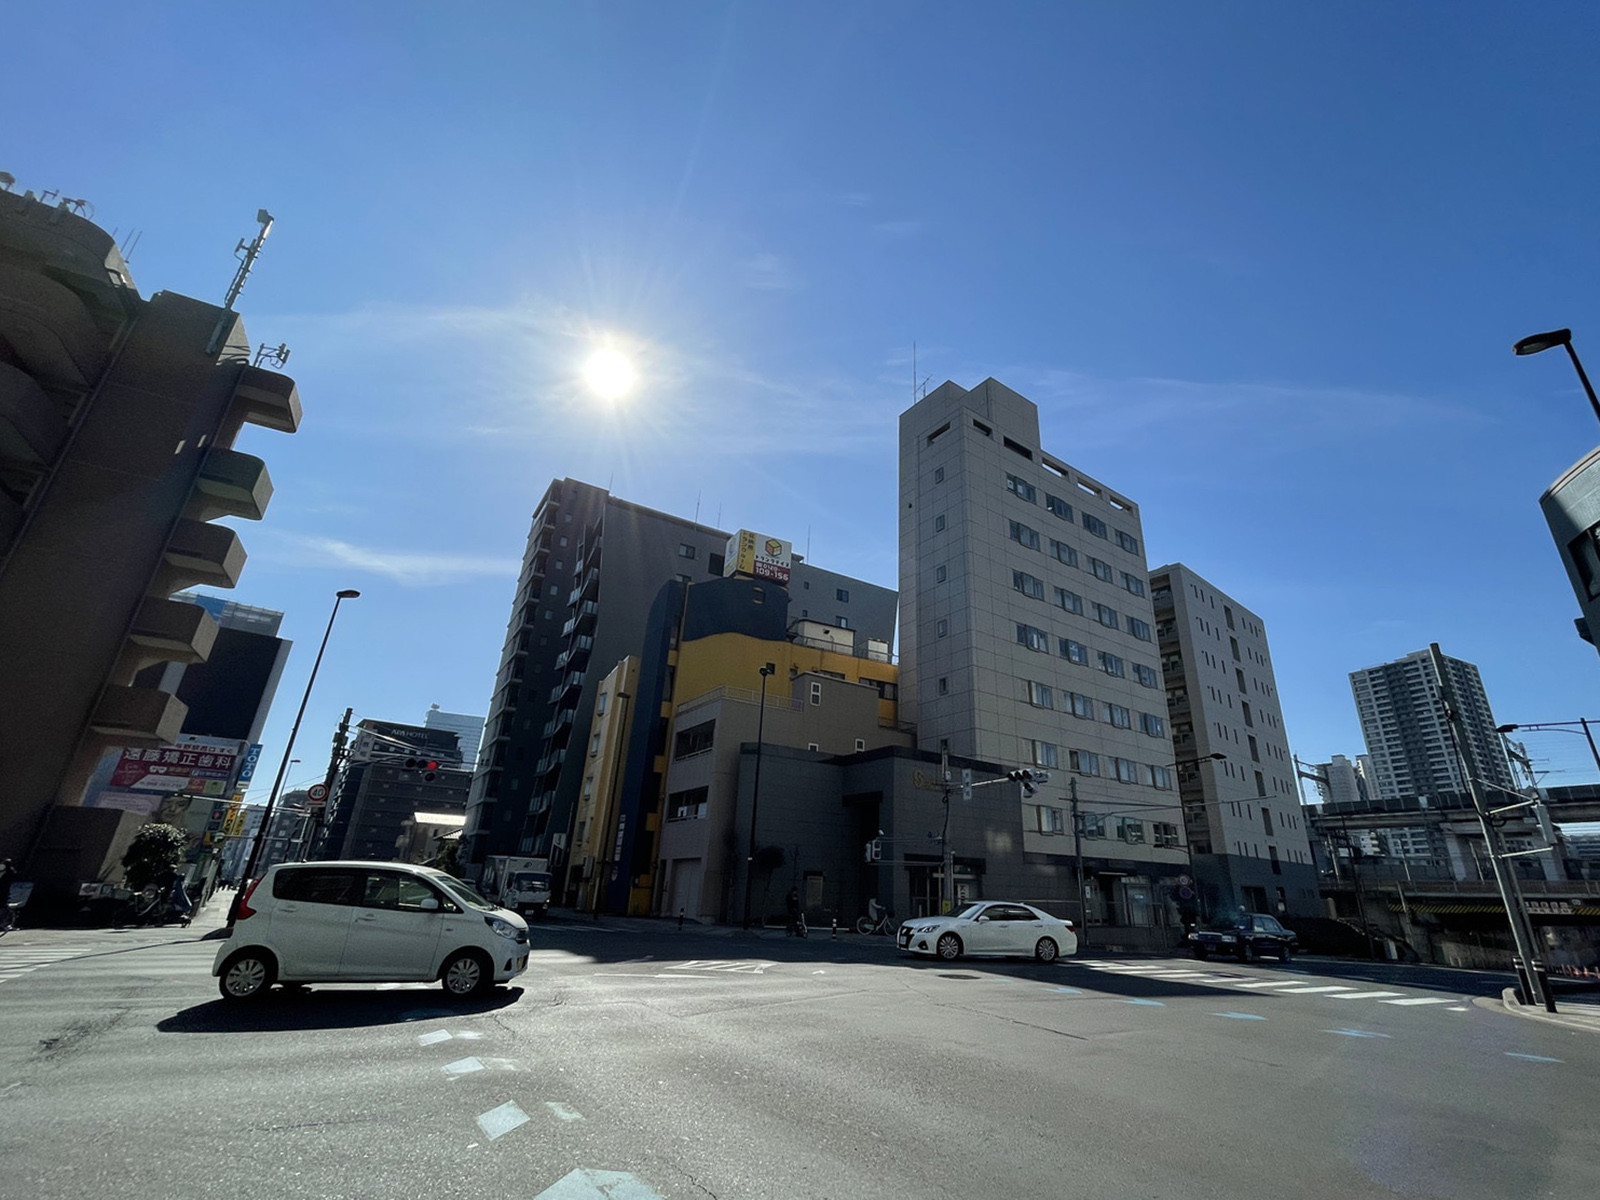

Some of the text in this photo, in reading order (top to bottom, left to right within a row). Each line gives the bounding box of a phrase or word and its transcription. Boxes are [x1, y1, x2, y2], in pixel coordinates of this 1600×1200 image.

[756, 567, 789, 581] 109-156
[406, 731, 429, 739] HOTEL
[123, 749, 231, 769] 遠藤矯正歯科
[242, 748, 260, 777] TOTO
[312, 788, 324, 797] 40
